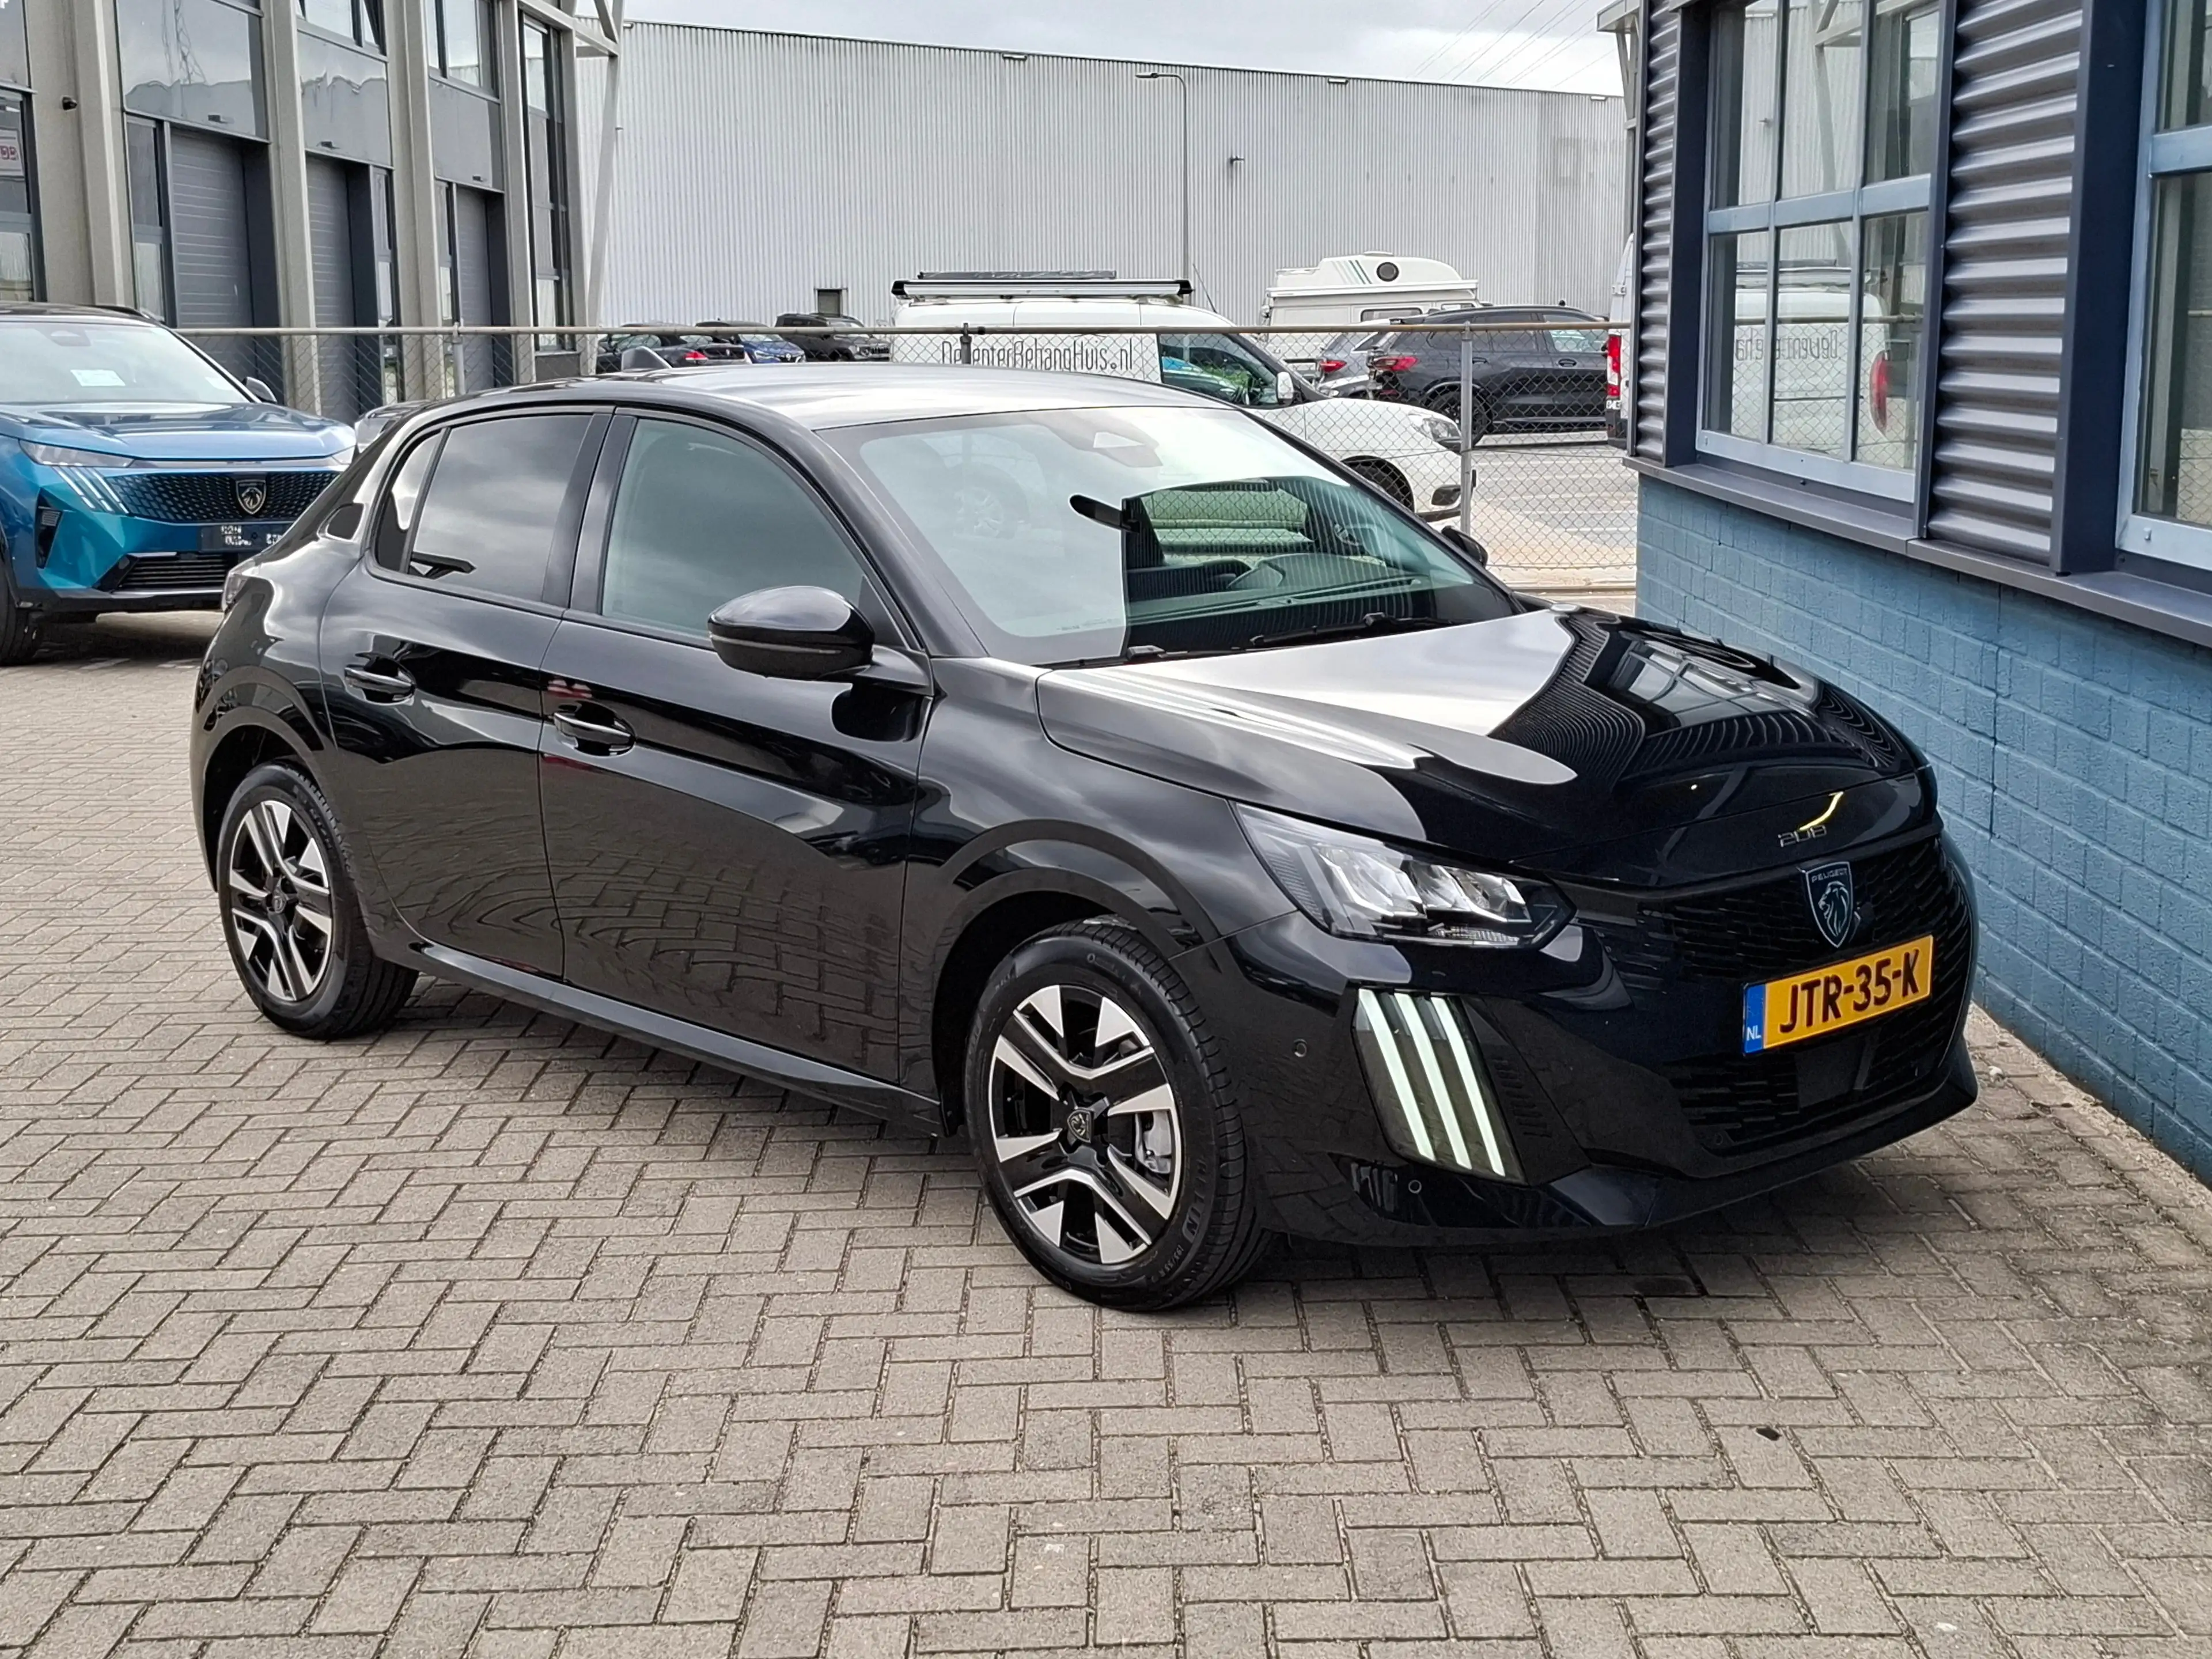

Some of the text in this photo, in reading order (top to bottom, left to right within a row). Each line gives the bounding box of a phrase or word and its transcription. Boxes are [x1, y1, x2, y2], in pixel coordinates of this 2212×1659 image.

[942, 338, 1132, 372] DeenterBehangHuis.nl
[1778, 824, 1828, 848] 208
[1811, 868, 1848, 884] PEUGEOT
[1779, 948, 1920, 1033] JTR-35-K
[1746, 1027, 1762, 1041] NL
